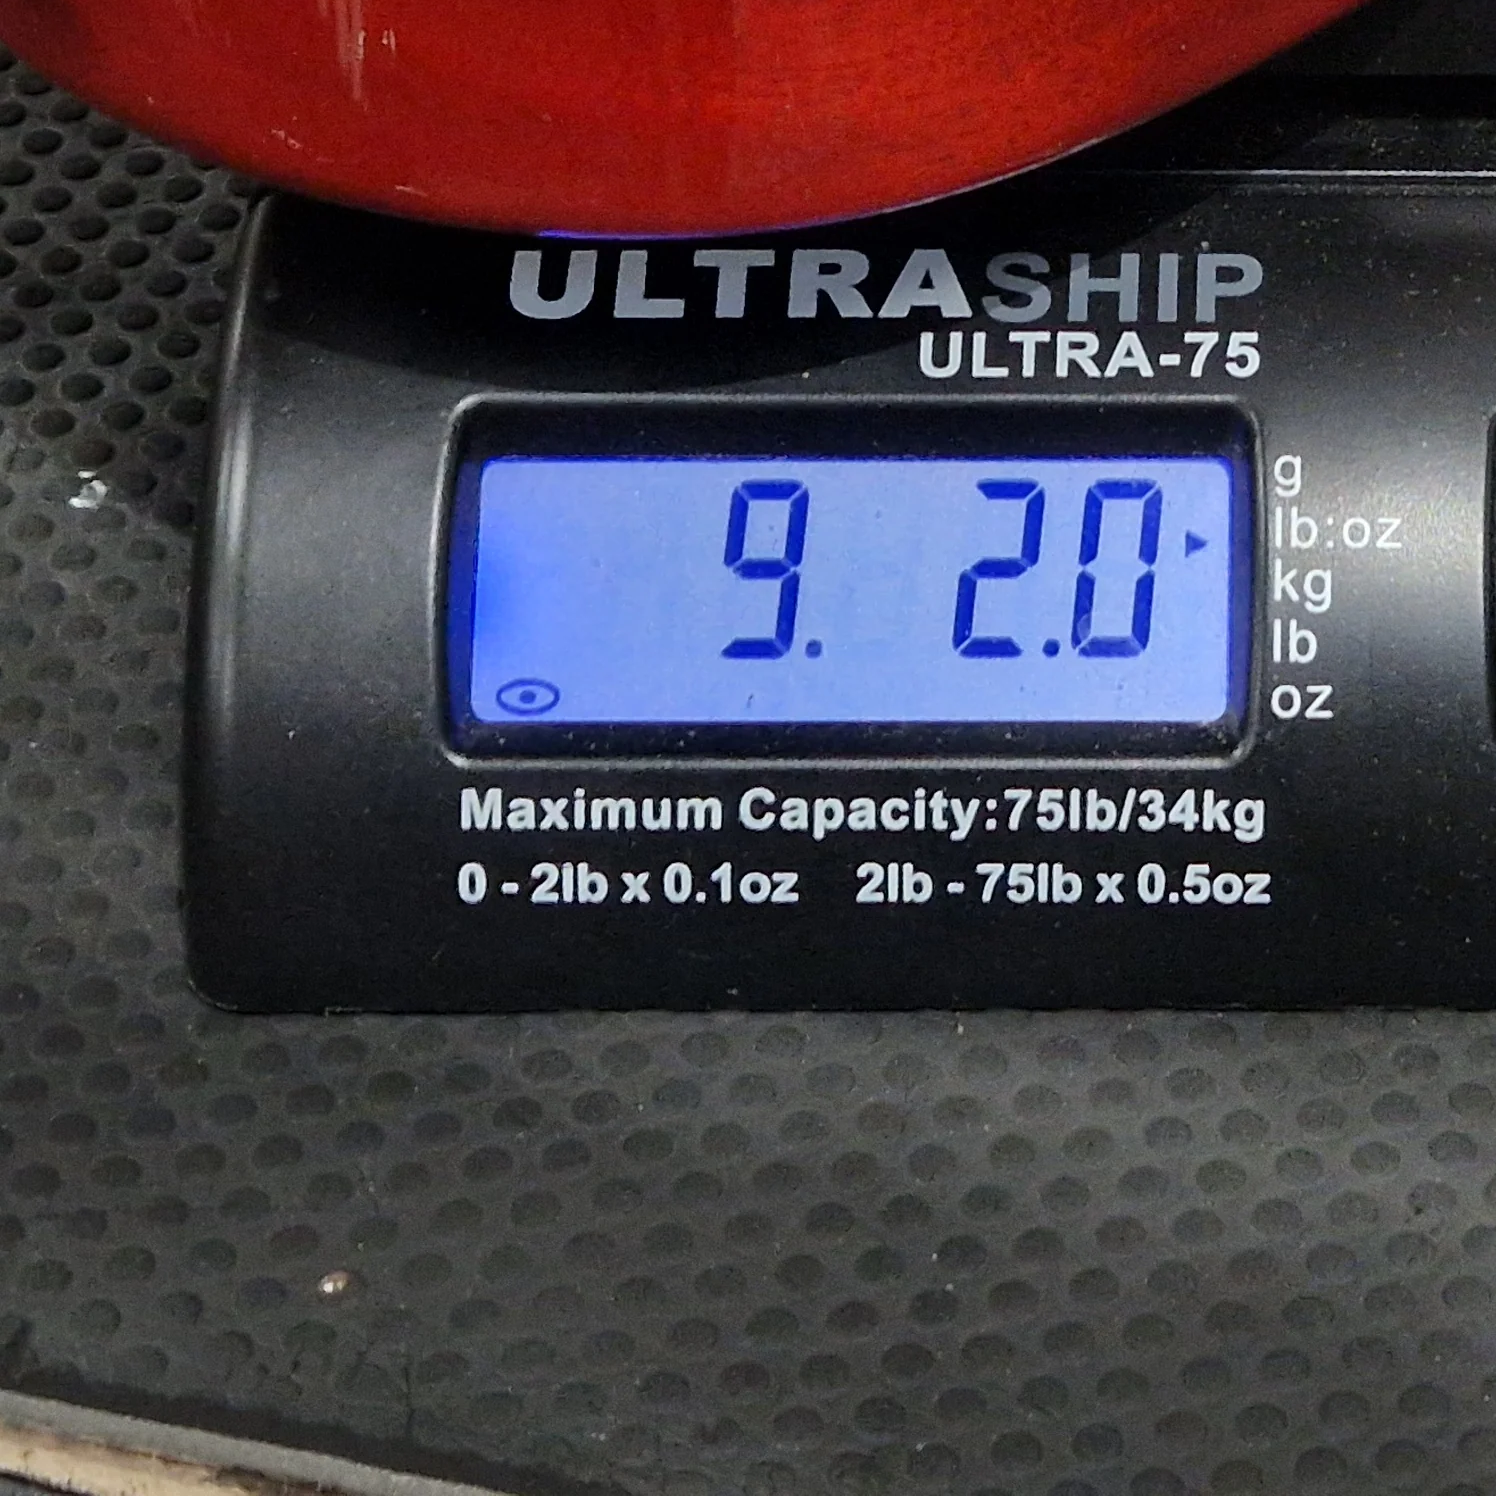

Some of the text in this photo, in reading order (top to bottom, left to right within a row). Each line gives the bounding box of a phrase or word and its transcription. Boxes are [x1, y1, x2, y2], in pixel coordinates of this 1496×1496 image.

[508, 248, 1264, 323] ULTRASHIP
[918, 330, 1262, 379] ULTRA-75
[1273, 453, 1304, 495] g
[1272, 506, 1402, 549] lb:oz
[951, 477, 1163, 659] 2.0
[1272, 561, 1333, 612] kg
[1271, 619, 1319, 665] lb
[1270, 682, 1334, 719] oz
[459, 787, 723, 831] Maximum
[457, 861, 487, 904] 0
[530, 861, 609, 904] 2lb
[620, 871, 651, 904] x
[663, 861, 800, 904] 0.1oz
[855, 861, 934, 904] 2lb
[975, 861, 1078, 904] 75lb
[1094, 871, 1125, 904] x
[1136, 861, 1272, 904] 0.5oz
